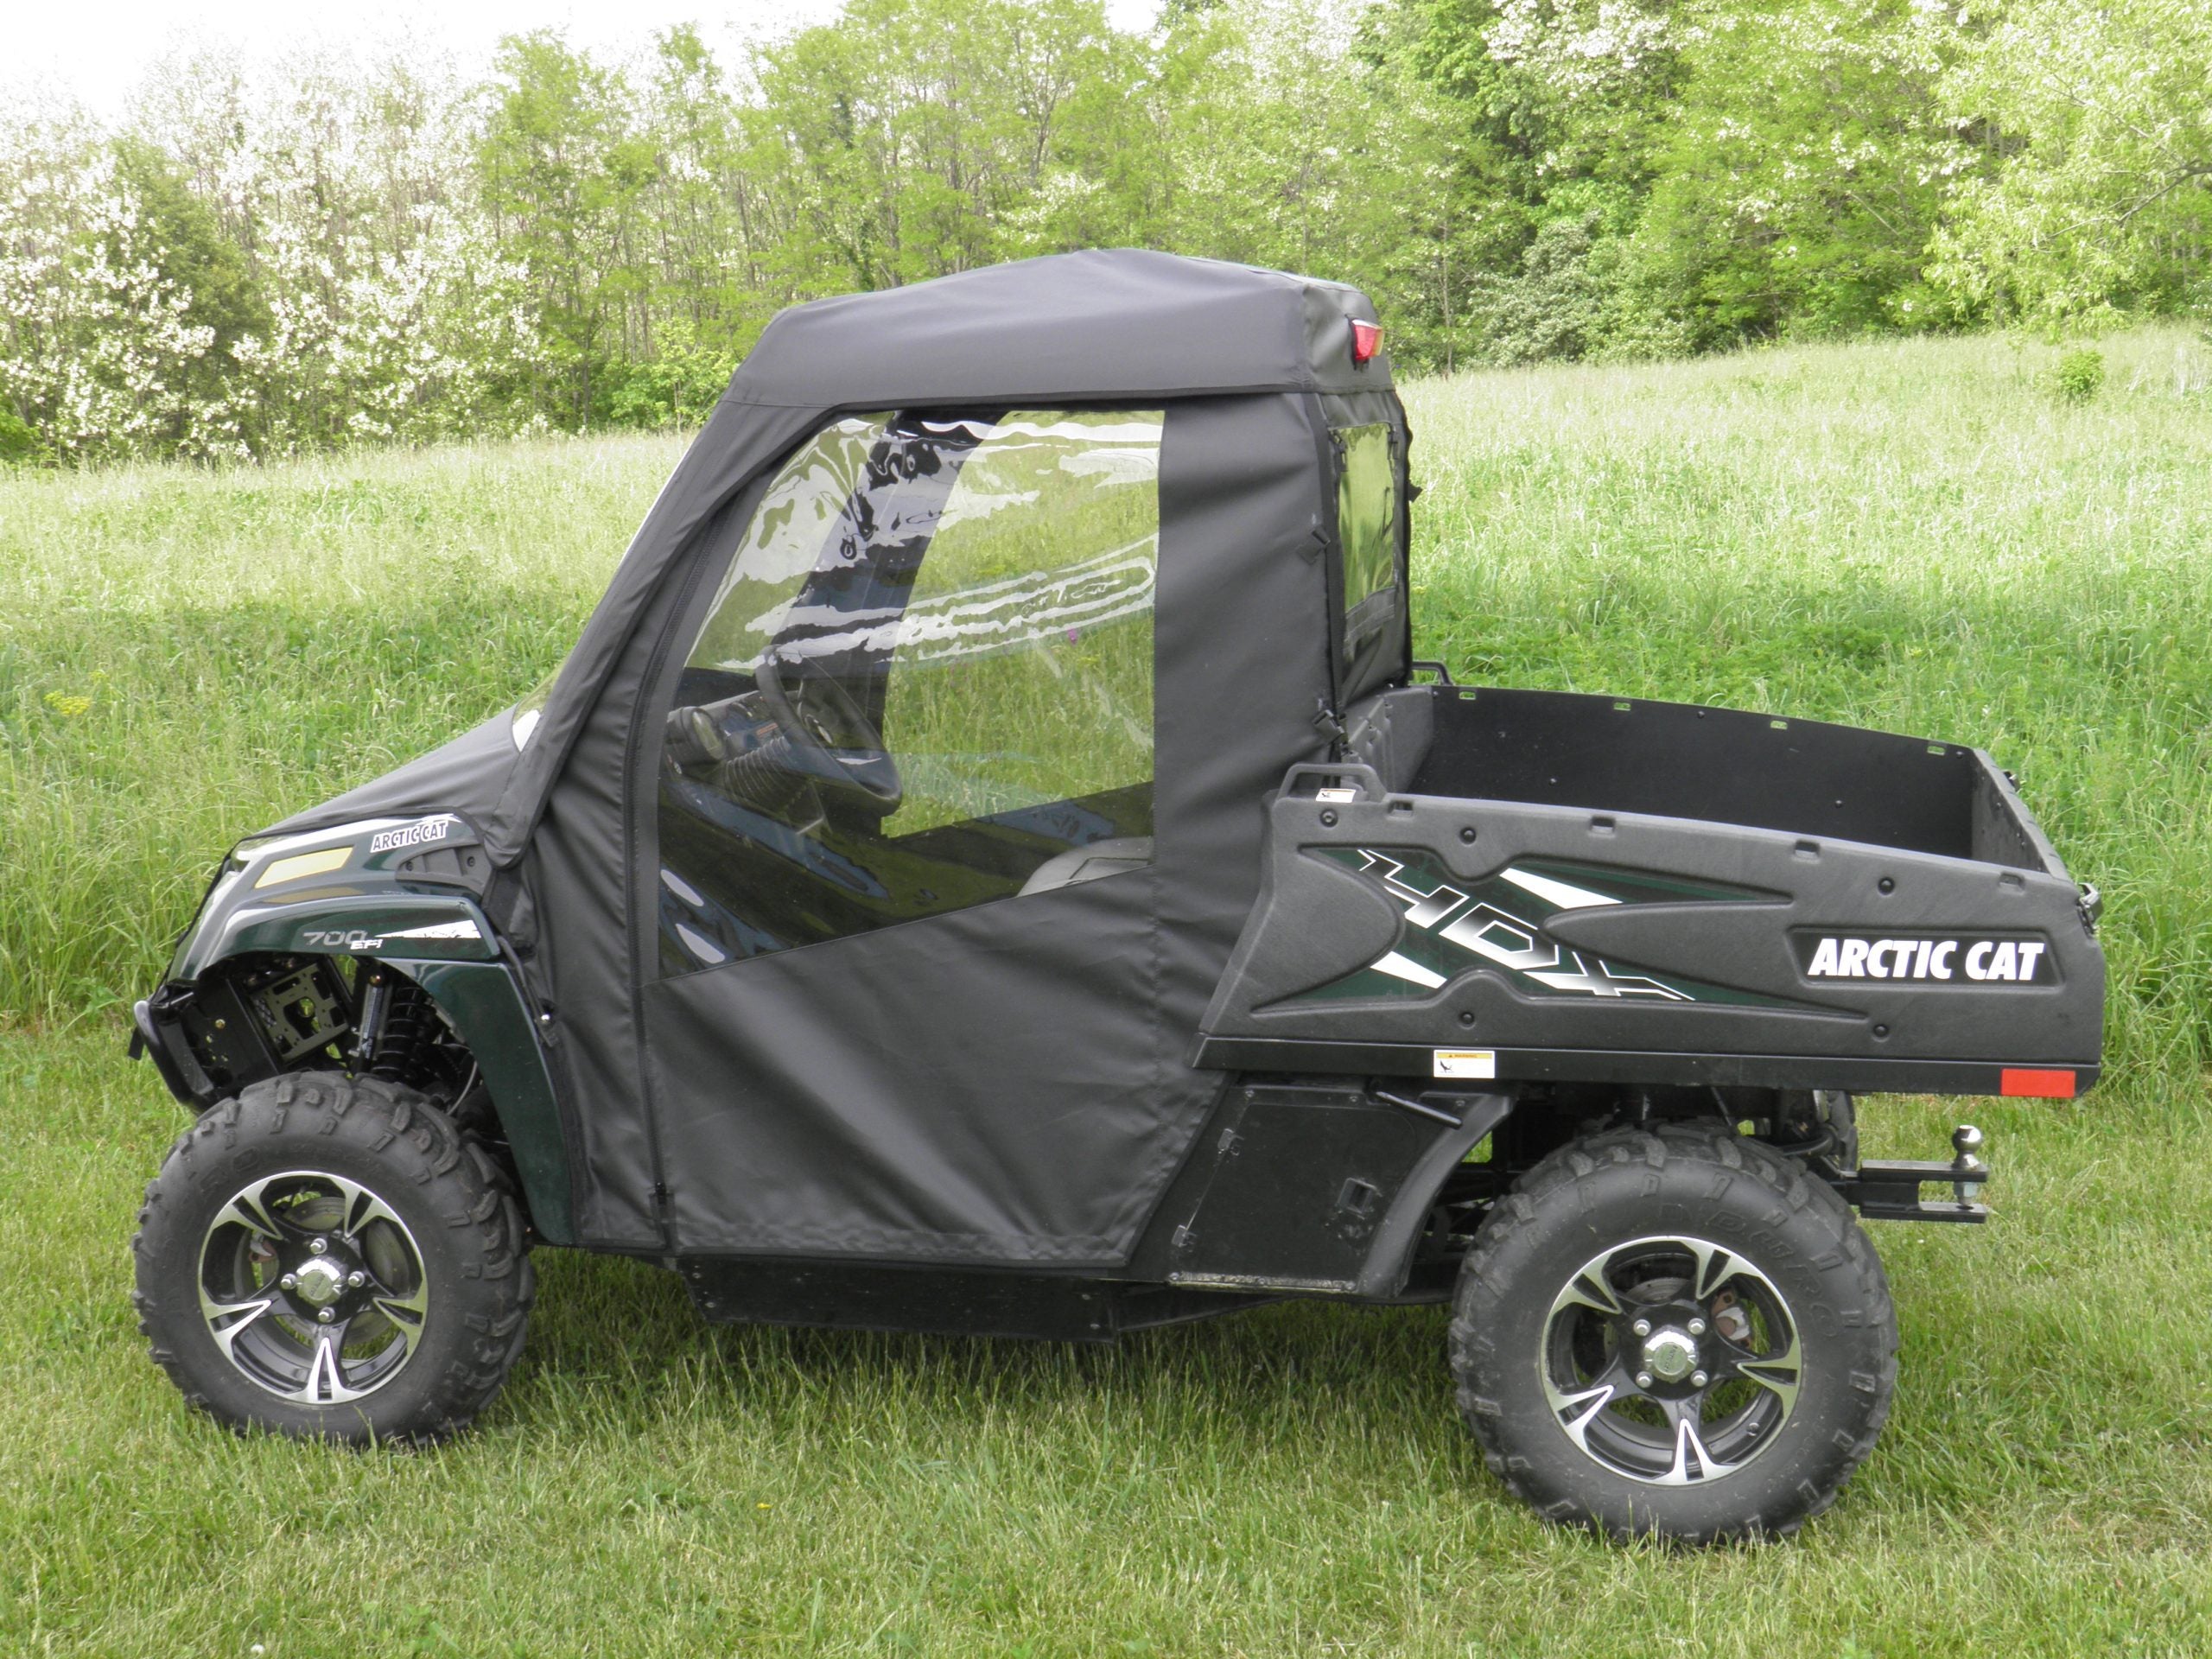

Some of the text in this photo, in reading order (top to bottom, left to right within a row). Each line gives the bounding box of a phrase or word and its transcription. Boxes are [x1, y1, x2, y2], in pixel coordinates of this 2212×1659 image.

[371, 821, 448, 852] ARCTIC CAT
[302, 930, 368, 946] 700
[350, 938, 384, 950] EFI
[1808, 938, 2044, 981] ARCTIC CAT
